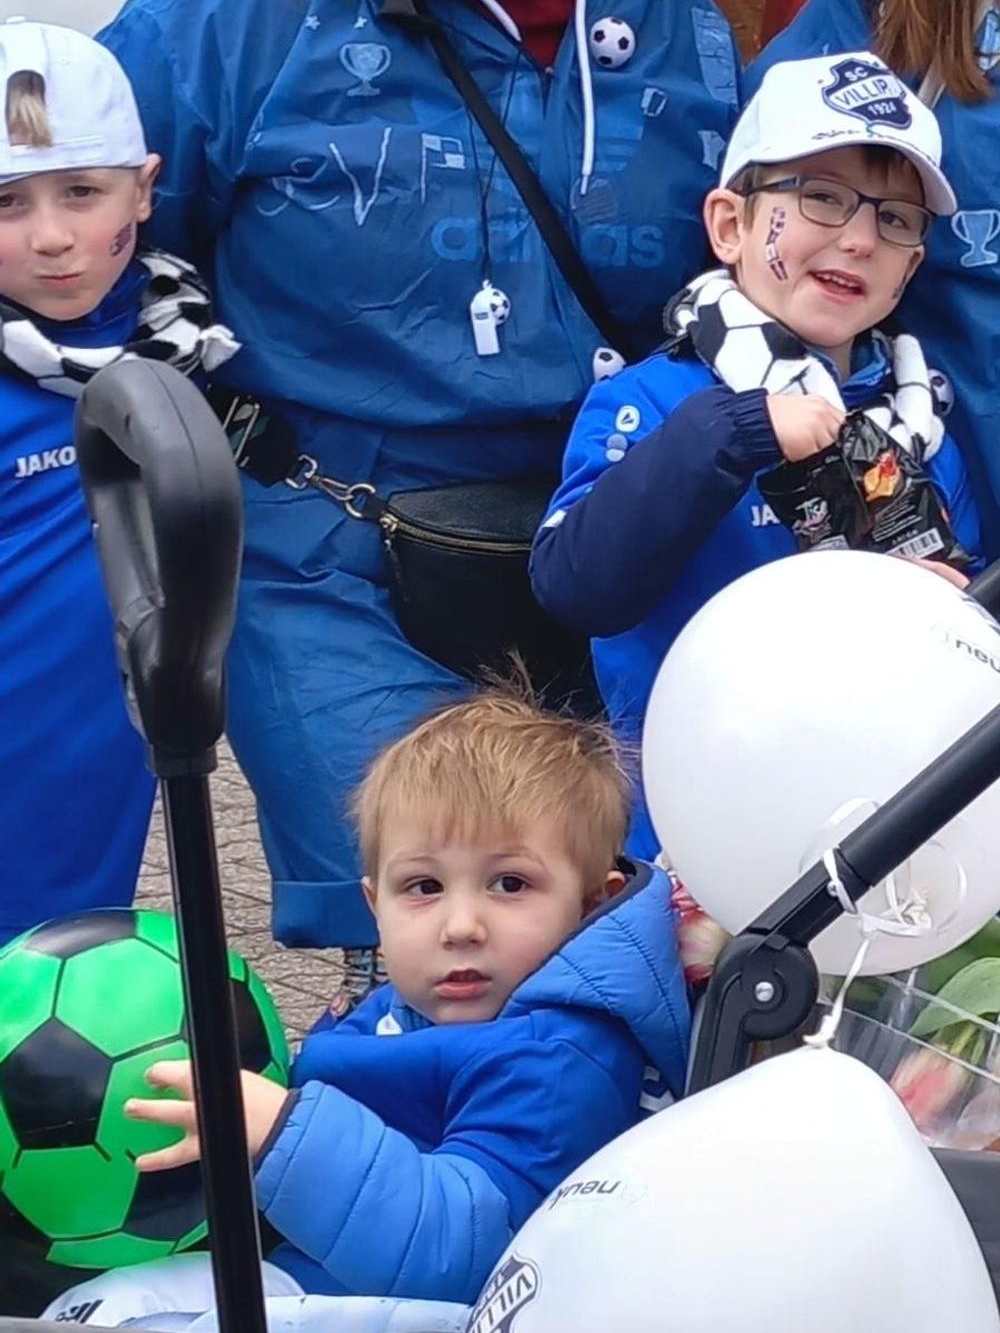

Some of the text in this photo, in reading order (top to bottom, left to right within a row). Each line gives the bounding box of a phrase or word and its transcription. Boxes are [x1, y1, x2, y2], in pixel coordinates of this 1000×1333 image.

[844, 66, 868, 82] SC
[834, 78, 889, 106] VILLIP
[15, 445, 77, 478] JAKO
